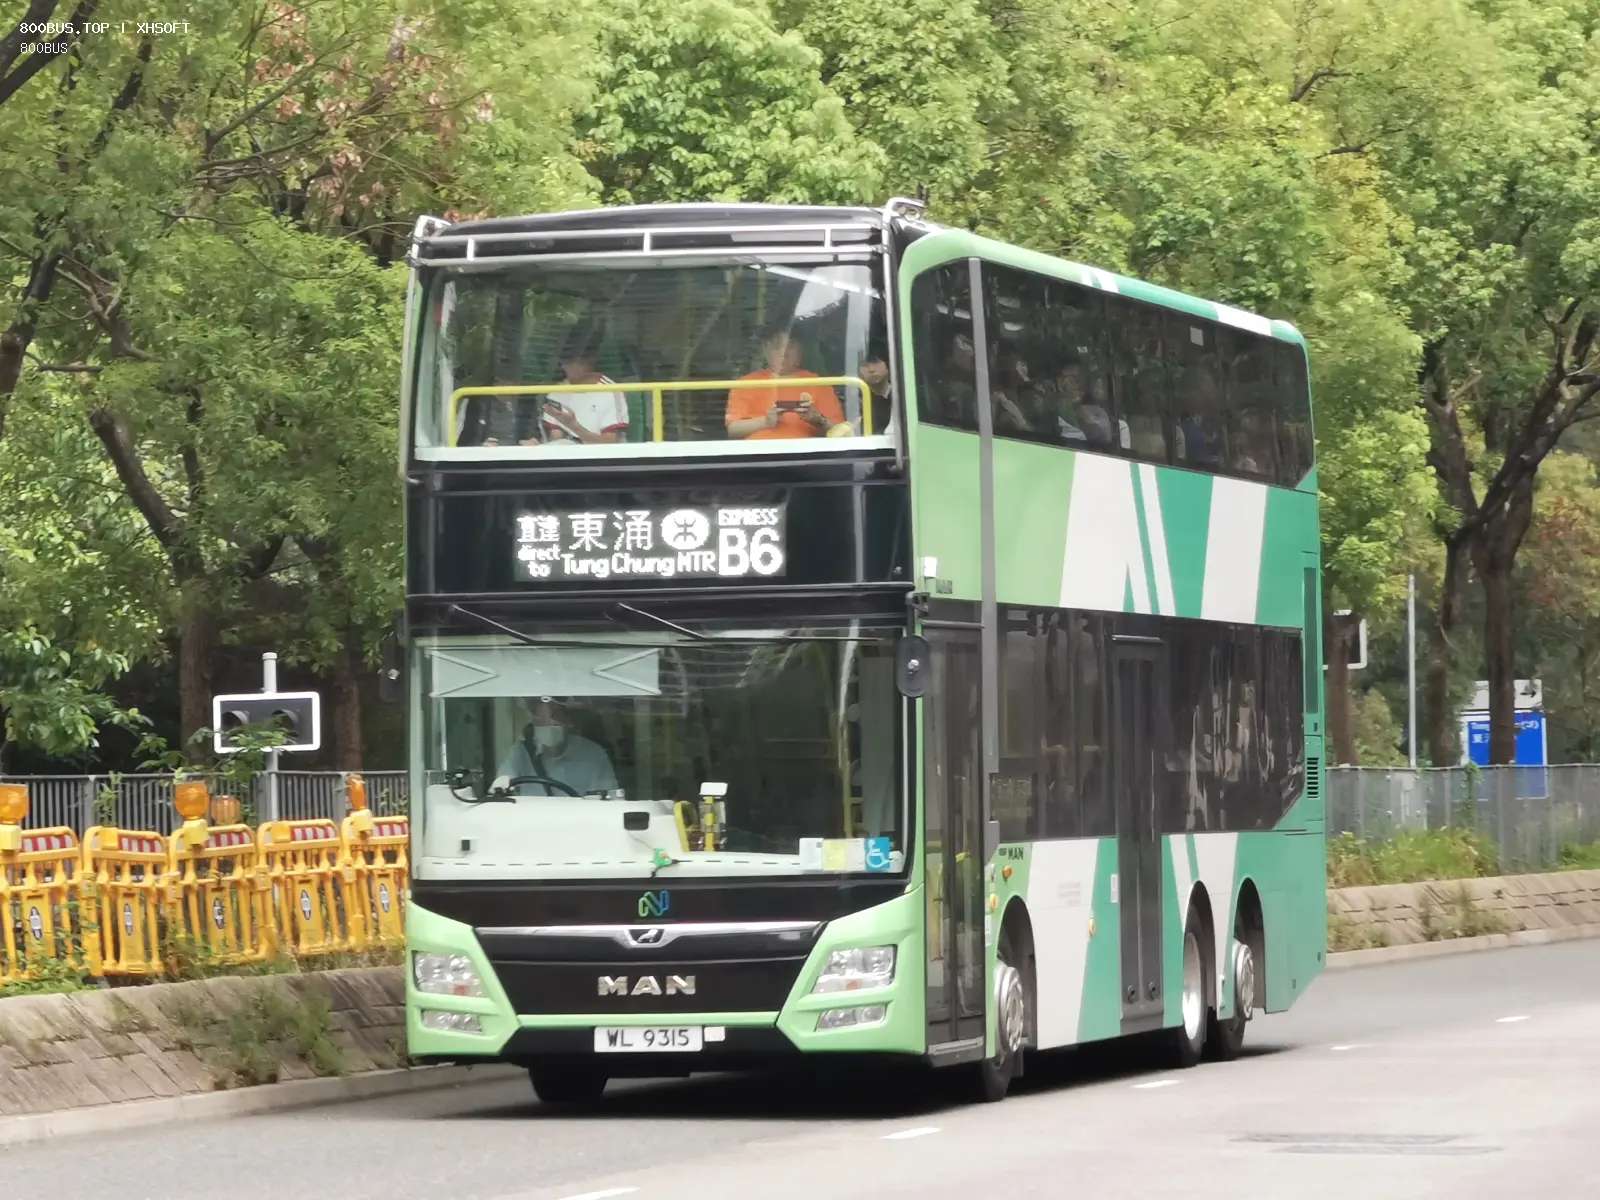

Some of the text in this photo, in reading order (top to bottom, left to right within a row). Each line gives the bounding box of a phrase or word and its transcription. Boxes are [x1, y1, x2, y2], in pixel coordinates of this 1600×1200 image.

[567, 510, 653, 551] 東涌
[560, 550, 717, 577] Tung Chung MTR
[718, 527, 783, 575] B6
[597, 975, 697, 996] MAN
[606, 1029, 690, 1048] WL 9315
